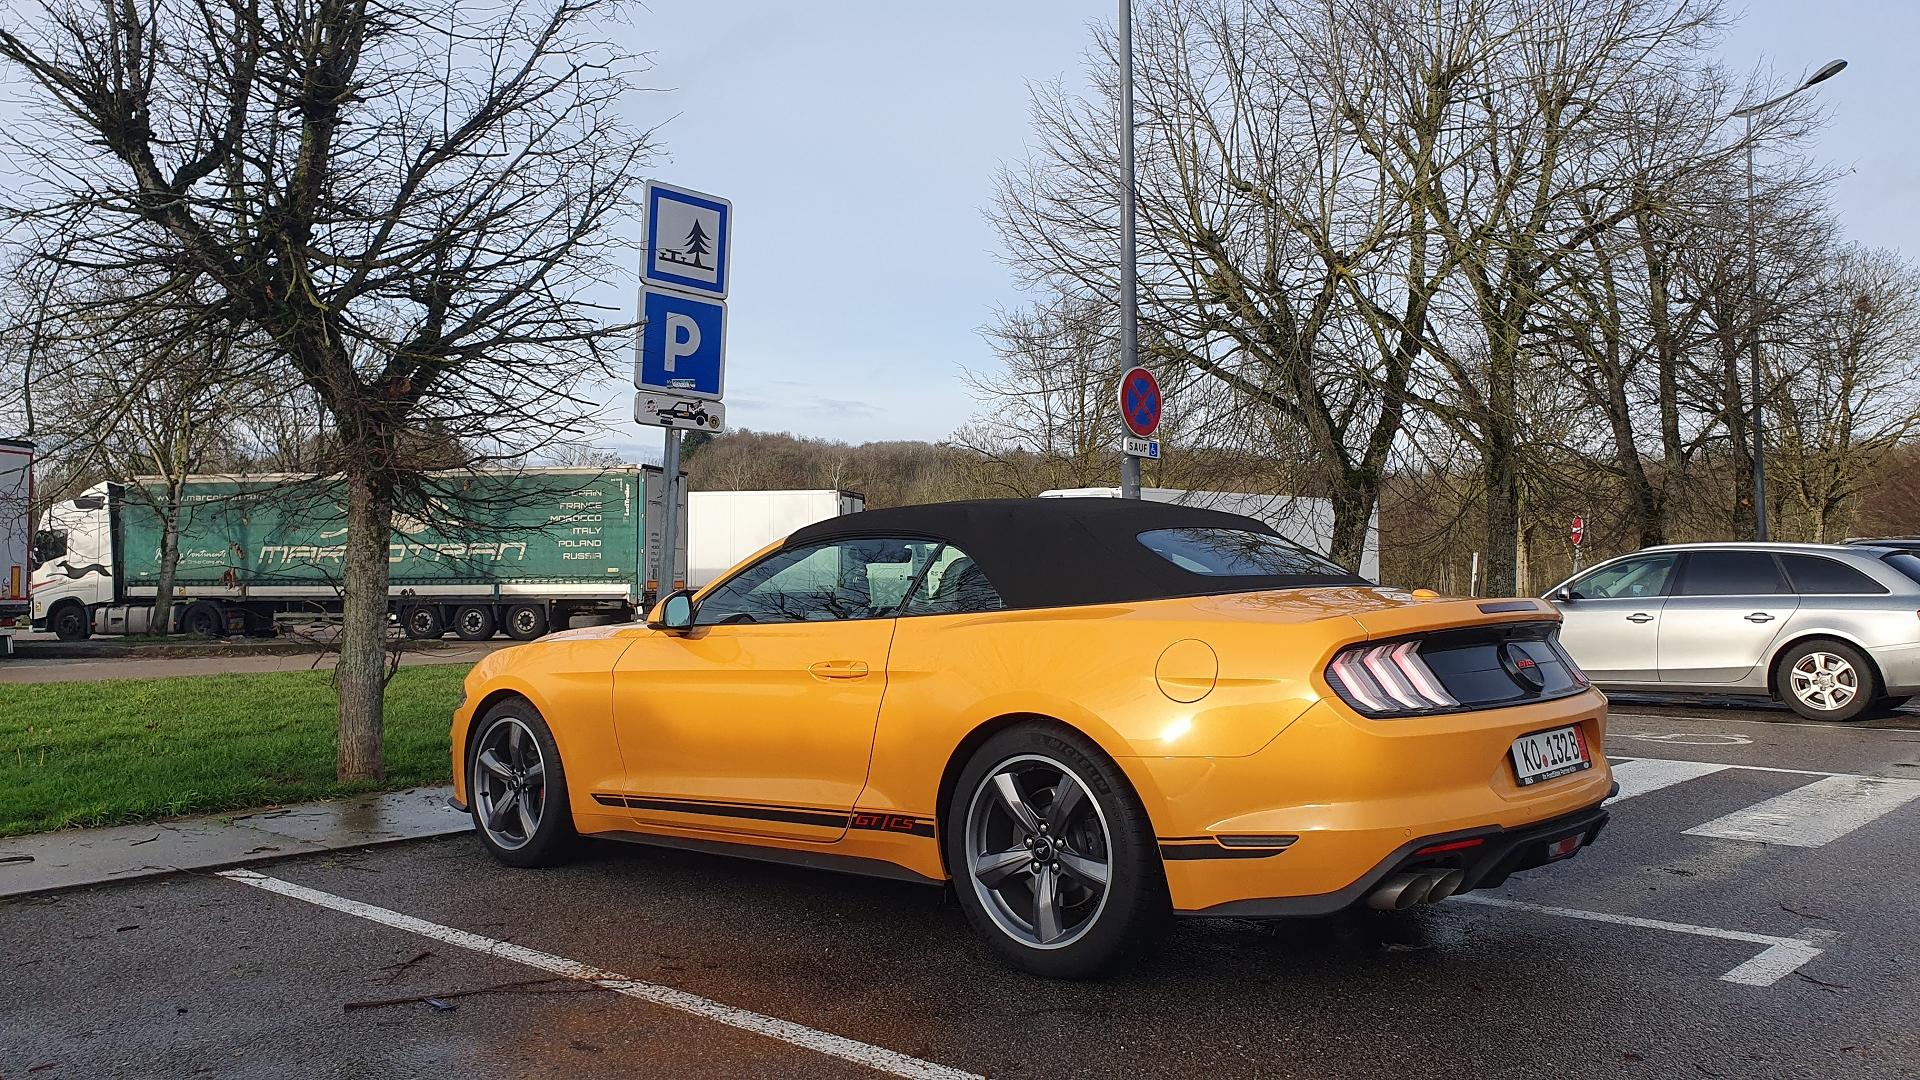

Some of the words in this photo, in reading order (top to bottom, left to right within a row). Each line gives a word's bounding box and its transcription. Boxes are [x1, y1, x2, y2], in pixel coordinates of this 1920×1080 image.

[664, 312, 701, 372] P
[1128, 442, 1148, 453] SAUF
[559, 502, 602, 510] FRANCE
[550, 514, 602, 522] MOROCCO
[572, 527, 602, 535] ITALY
[558, 539, 602, 547] POLAND
[258, 543, 526, 564] MAROTRAN
[563, 552, 602, 560] RUSSIA
[1520, 739, 1542, 772] KO
